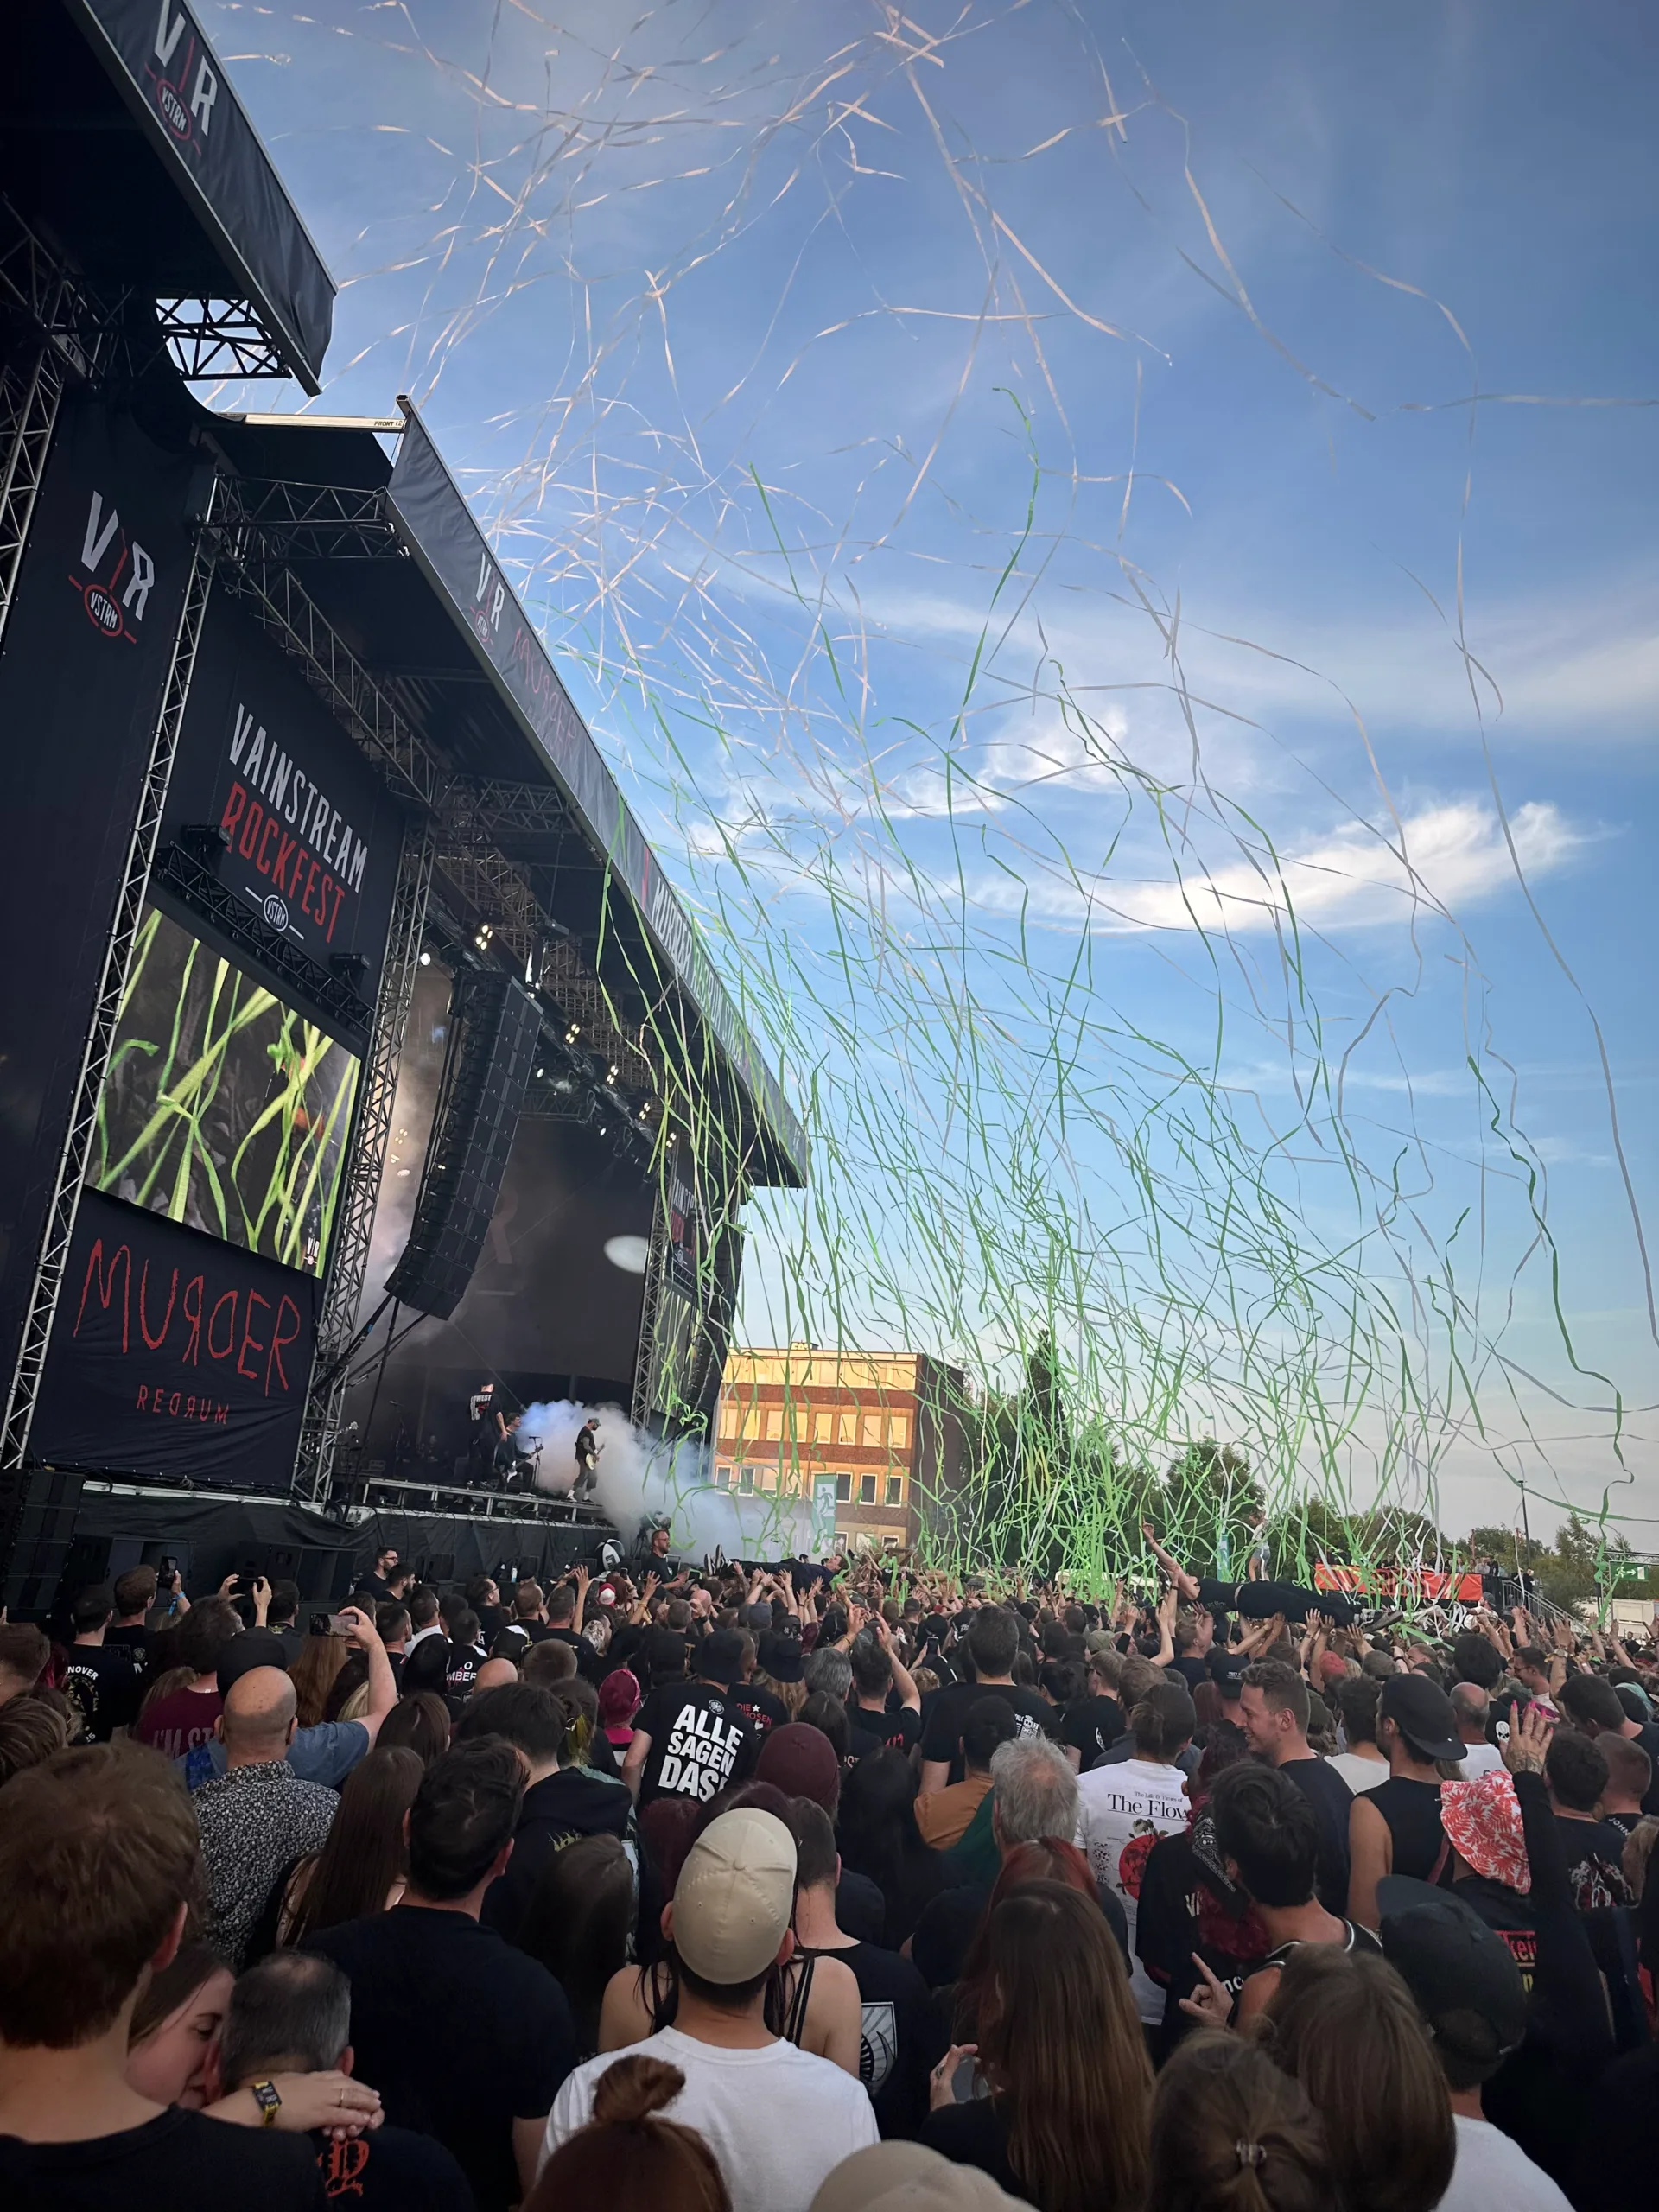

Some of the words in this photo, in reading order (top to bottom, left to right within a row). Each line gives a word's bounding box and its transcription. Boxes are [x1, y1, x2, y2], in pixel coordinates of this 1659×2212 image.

[162, 86, 187, 131] VSTRM
[91, 592, 118, 629] VSTRM
[229, 702, 368, 893] VAINSTREAM
[221, 781, 346, 944] ROCKFEST
[266, 899, 287, 926] VSTRM
[73, 1238, 301, 1397] MURDER
[137, 1384, 230, 1425] REDRUM
[67, 1664, 99, 1681] NOVER
[673, 1704, 744, 1758] ALLE
[667, 1731, 736, 1777] SAGEN
[1107, 1793, 1143, 1814] The
